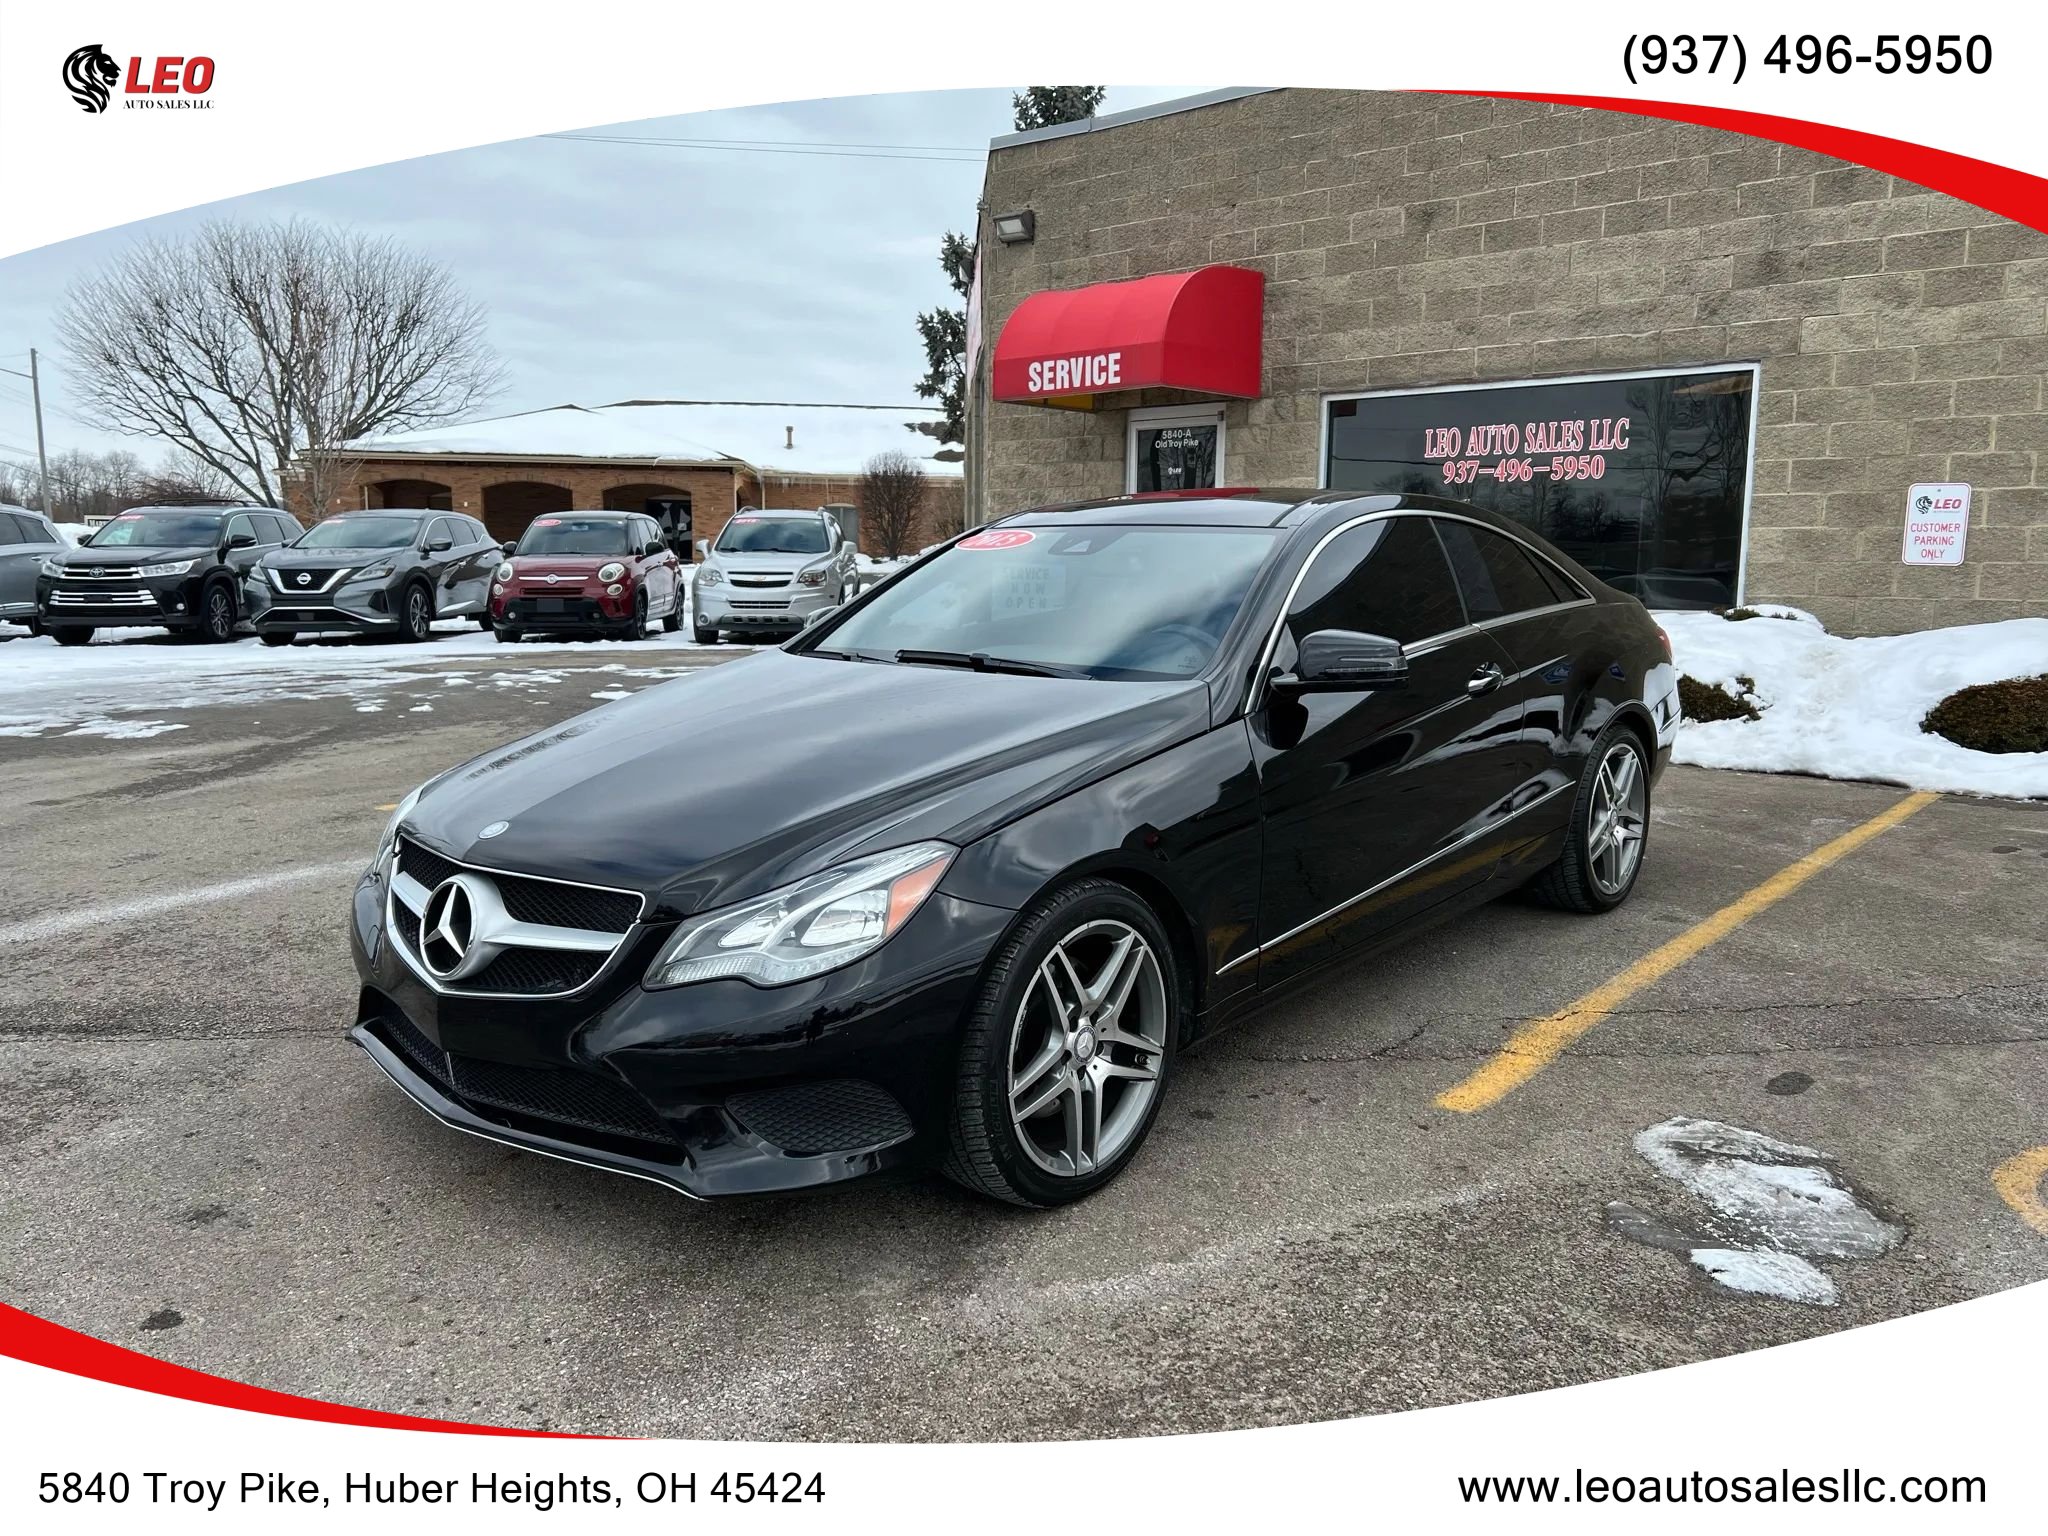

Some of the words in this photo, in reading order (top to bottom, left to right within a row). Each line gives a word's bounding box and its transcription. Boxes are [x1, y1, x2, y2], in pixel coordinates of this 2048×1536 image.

[1028, 352, 1121, 392] SERVICE
[1162, 429, 1192, 440] 5840-A
[1424, 427, 1461, 459] LEO
[1465, 423, 1520, 457] AUTO
[1524, 419, 1584, 453] SALES
[1589, 417, 1630, 451] LLC
[1155, 440, 1168, 449] Old
[1168, 439, 1183, 449] Troy
[1183, 438, 1199, 448] Pike
[1442, 454, 1605, 485] 937-496-5950
[1933, 498, 1963, 509] LEO
[1910, 523, 1961, 533] CUSTOMER
[1914, 536, 1955, 546] PARKING
[1920, 549, 1945, 559] ONLY
